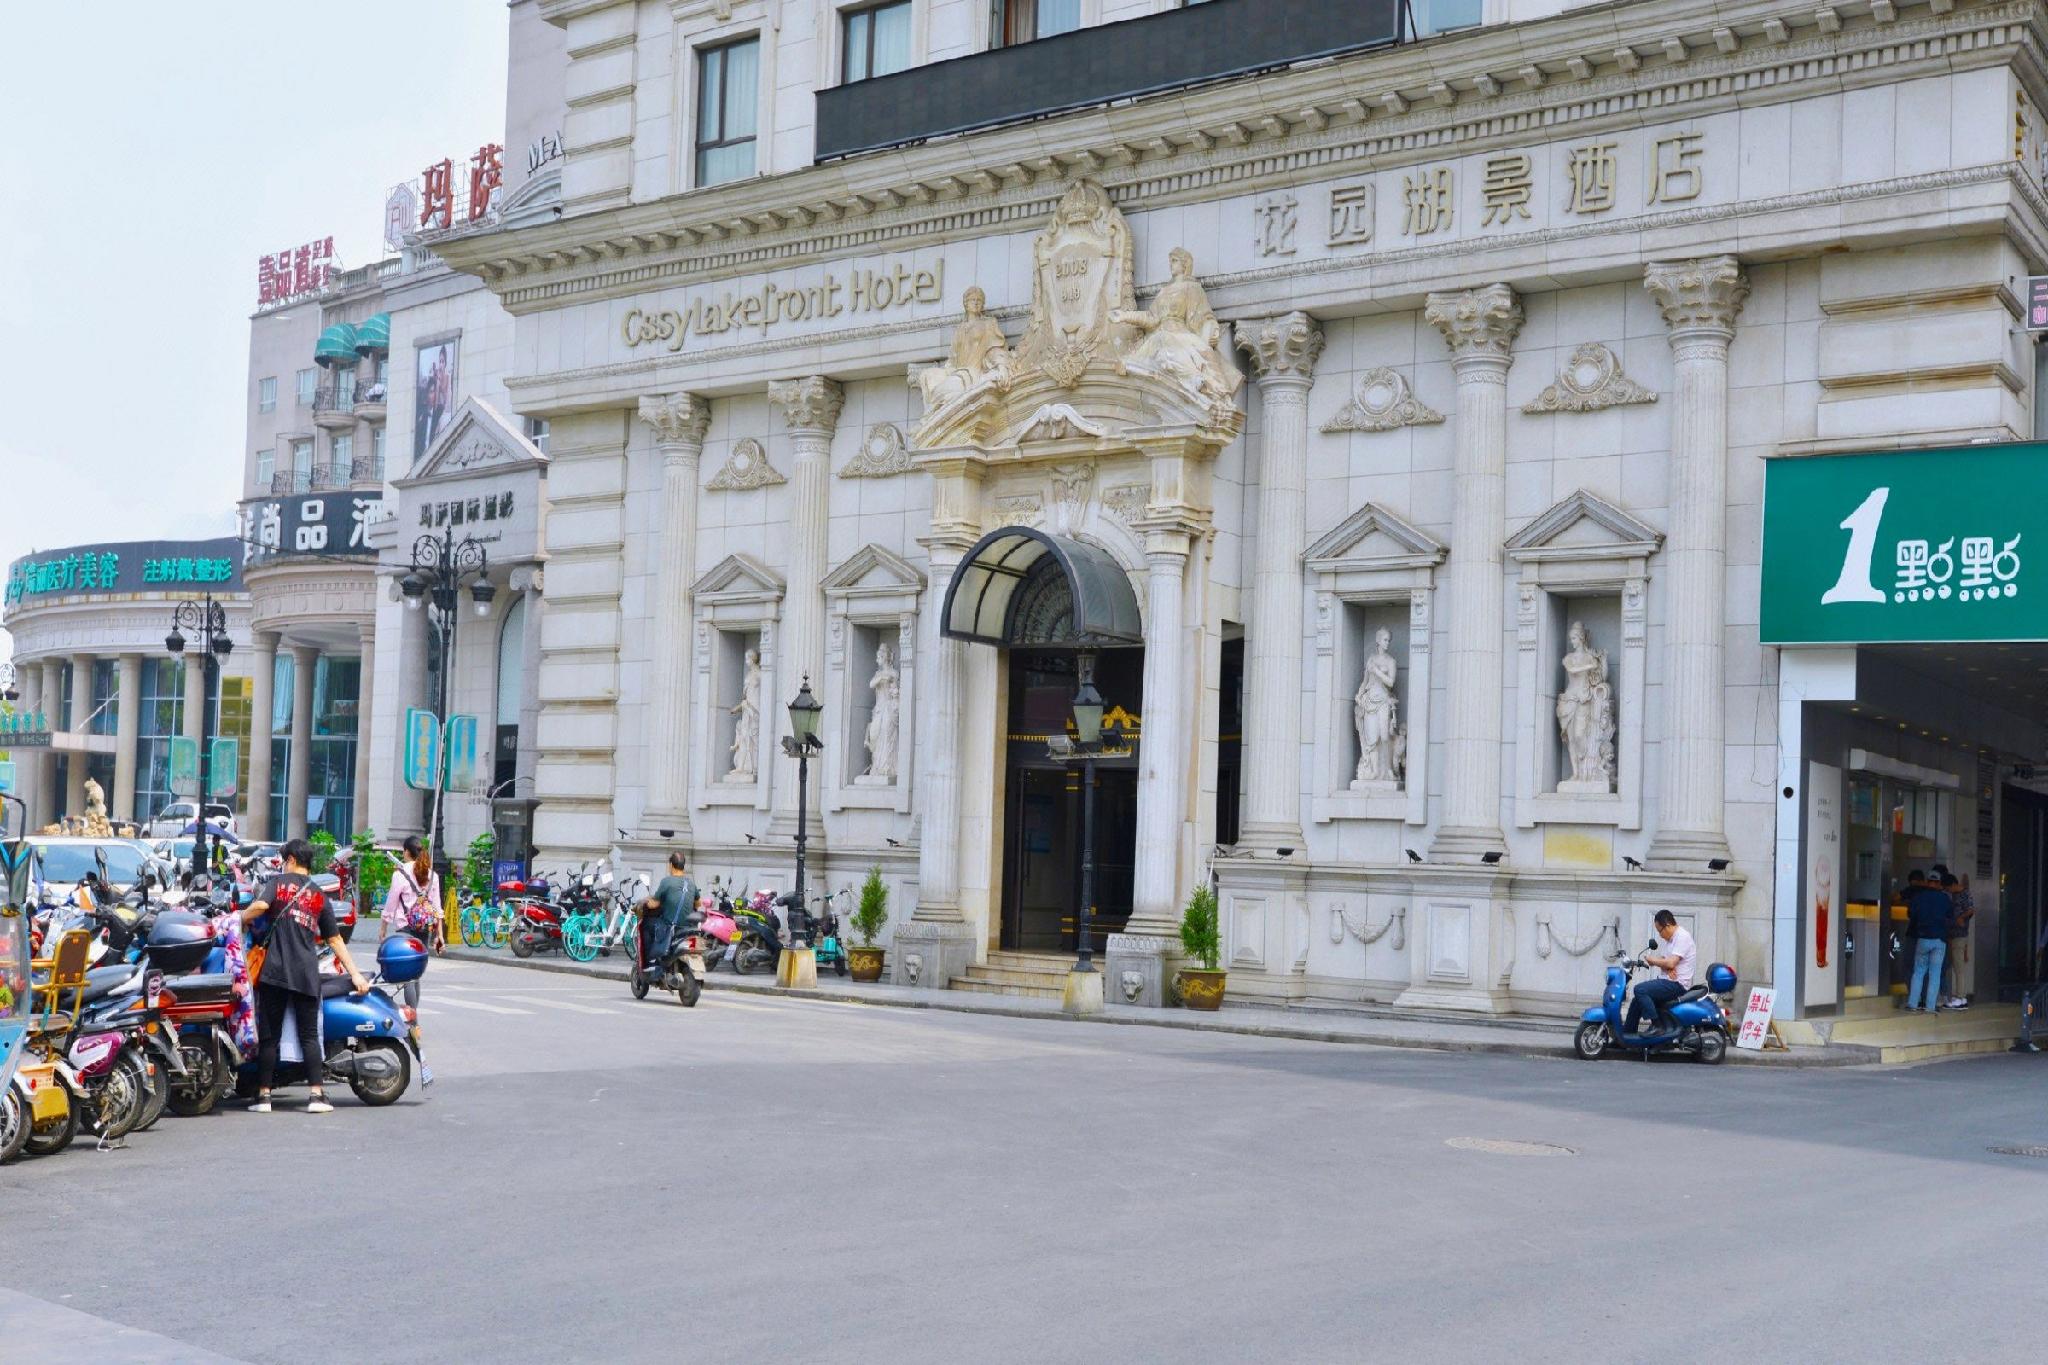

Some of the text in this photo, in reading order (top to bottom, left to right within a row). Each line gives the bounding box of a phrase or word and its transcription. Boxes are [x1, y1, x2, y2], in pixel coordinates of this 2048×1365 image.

[1255, 131, 1706, 258] 花园湖景酒店
[850, 257, 944, 313] Hotel
